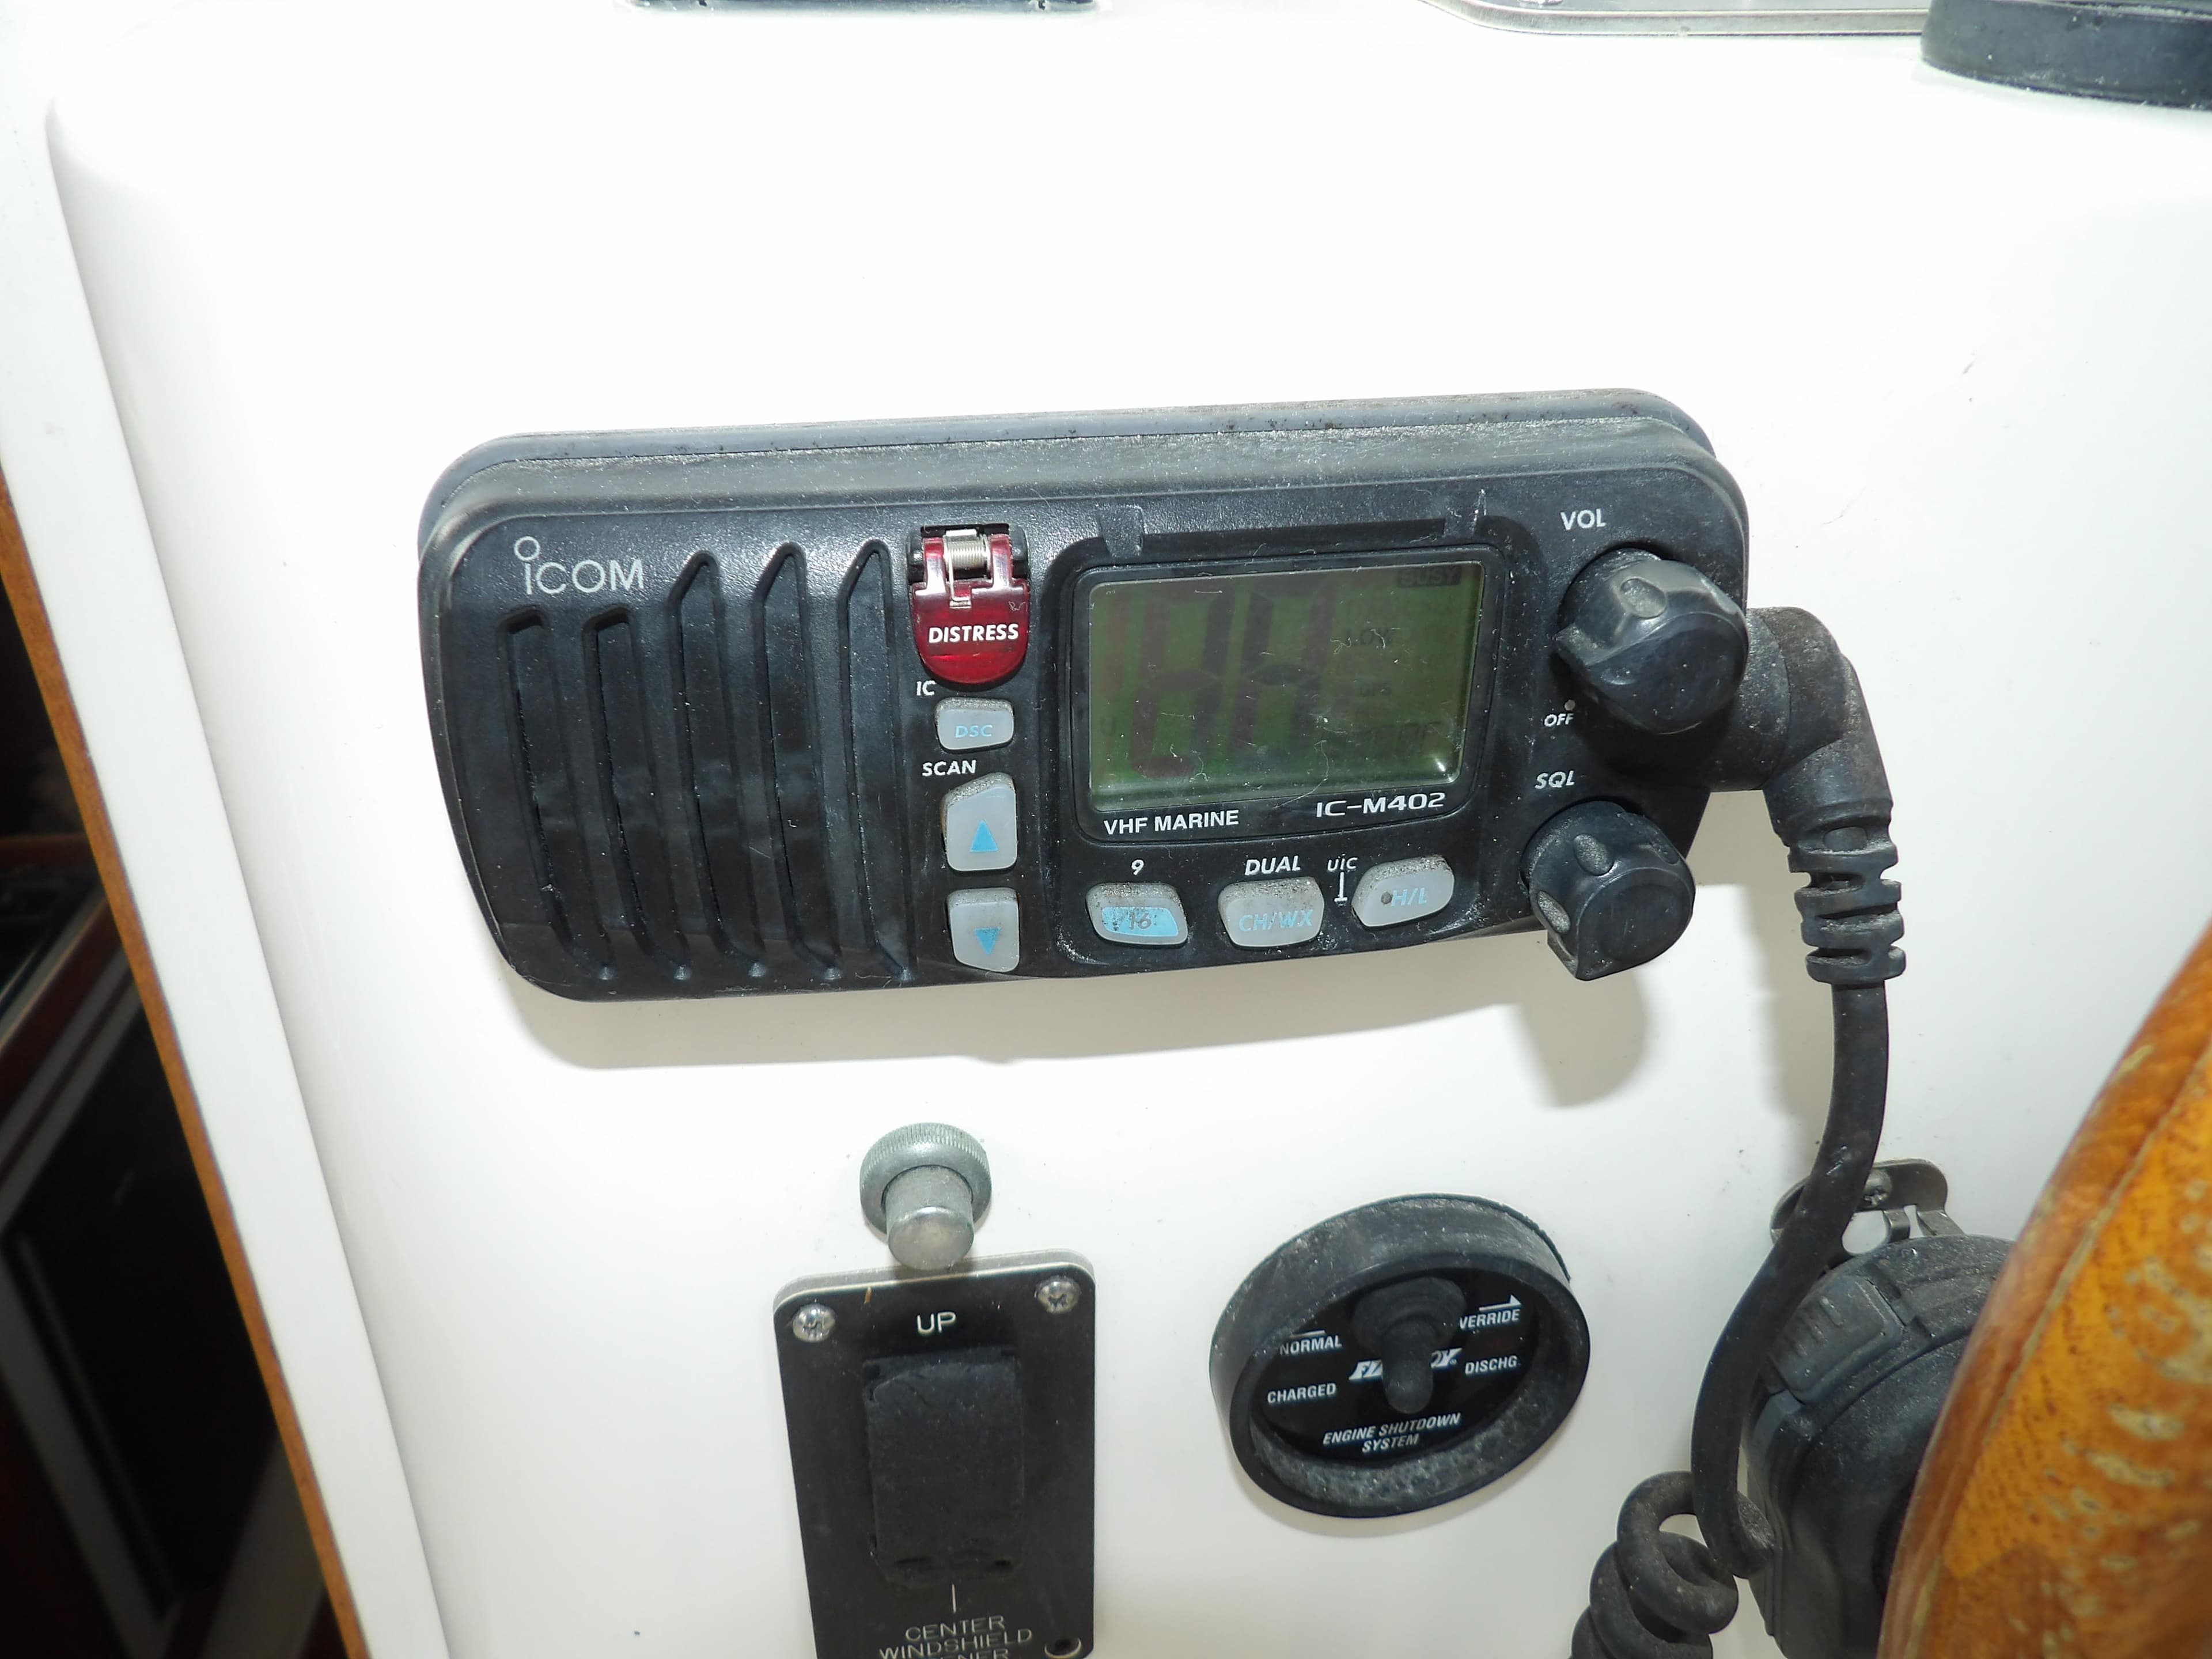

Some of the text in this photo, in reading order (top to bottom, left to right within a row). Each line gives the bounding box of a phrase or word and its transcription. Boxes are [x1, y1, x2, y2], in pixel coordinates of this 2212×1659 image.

[1560, 509, 1607, 530] VOL
[929, 623, 1019, 643] DISTRESS
[916, 680, 936, 696] IC
[1543, 714, 1574, 728] OFF
[955, 725, 993, 738] DSC
[922, 760, 976, 777] SCAN
[1535, 770, 1575, 790] SQL
[1316, 791, 1446, 817] IC-M402
[1103, 810, 1239, 835] VHF MARINE
[1131, 859, 1144, 876] 9
[1245, 855, 1301, 875] DUAL
[1391, 887, 1427, 906] H/L
[1129, 911, 1152, 931] 16
[1238, 909, 1313, 931] CH/WX
[917, 1312, 957, 1334] UP
[1459, 1309, 1520, 1329] VERRIDE
[1279, 1334, 1342, 1355] NORMAL
[1464, 1355, 1518, 1374] DISCHG
[1267, 1383, 1336, 1404] CHARGED
[1323, 1412, 1461, 1444] ENGINE SHUTDOWN
[1362, 1434, 1419, 1453] SYSTEM
[905, 1615, 1006, 1642] CENTER
[879, 1628, 1033, 1659] WINDSHIELD
